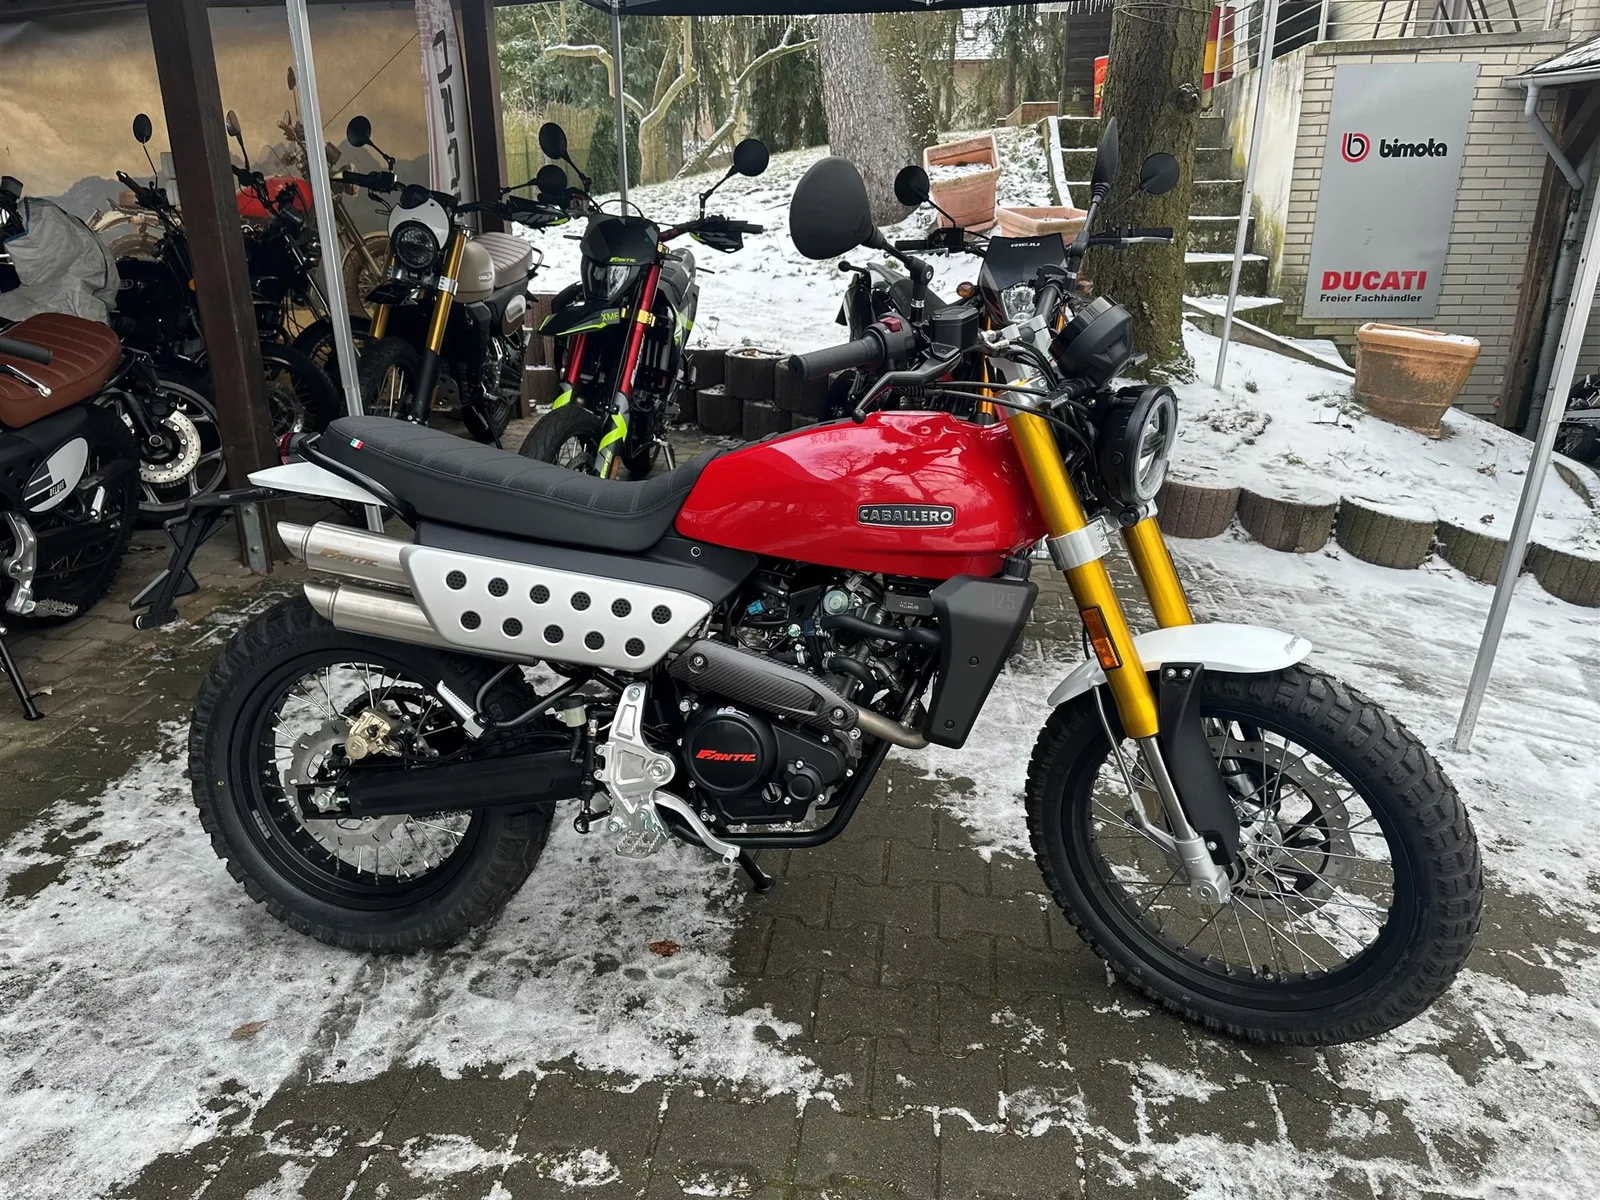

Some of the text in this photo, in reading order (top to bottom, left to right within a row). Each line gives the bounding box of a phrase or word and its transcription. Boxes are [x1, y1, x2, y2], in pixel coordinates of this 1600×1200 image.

[1379, 138, 1448, 158] bimota
[1321, 271, 1427, 290] DUCATI
[1320, 294, 1422, 302] Freier Fachhändler
[49, 480, 64, 497] DELUXE
[860, 509, 952, 522] CABALLERO
[320, 548, 379, 567] FANTIC
[991, 591, 1016, 610] 125
[696, 749, 757, 762] FANTIC
